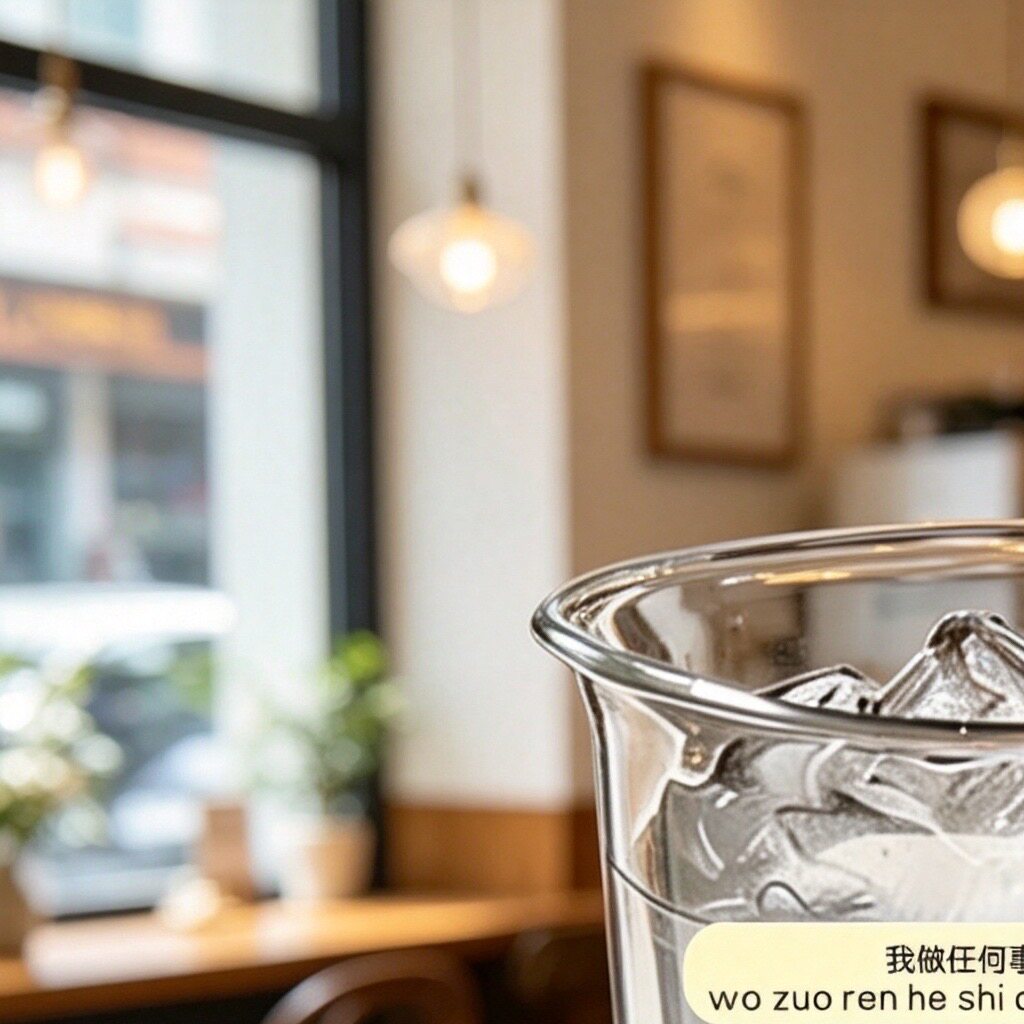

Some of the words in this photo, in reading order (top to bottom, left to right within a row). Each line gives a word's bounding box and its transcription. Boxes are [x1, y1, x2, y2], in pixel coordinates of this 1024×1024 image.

[708, 990, 761, 1012] wo
[772, 990, 833, 1012] zuo
[843, 990, 897, 1011] ren
[908, 983, 947, 1011] he
[958, 983, 1004, 1012] shi
